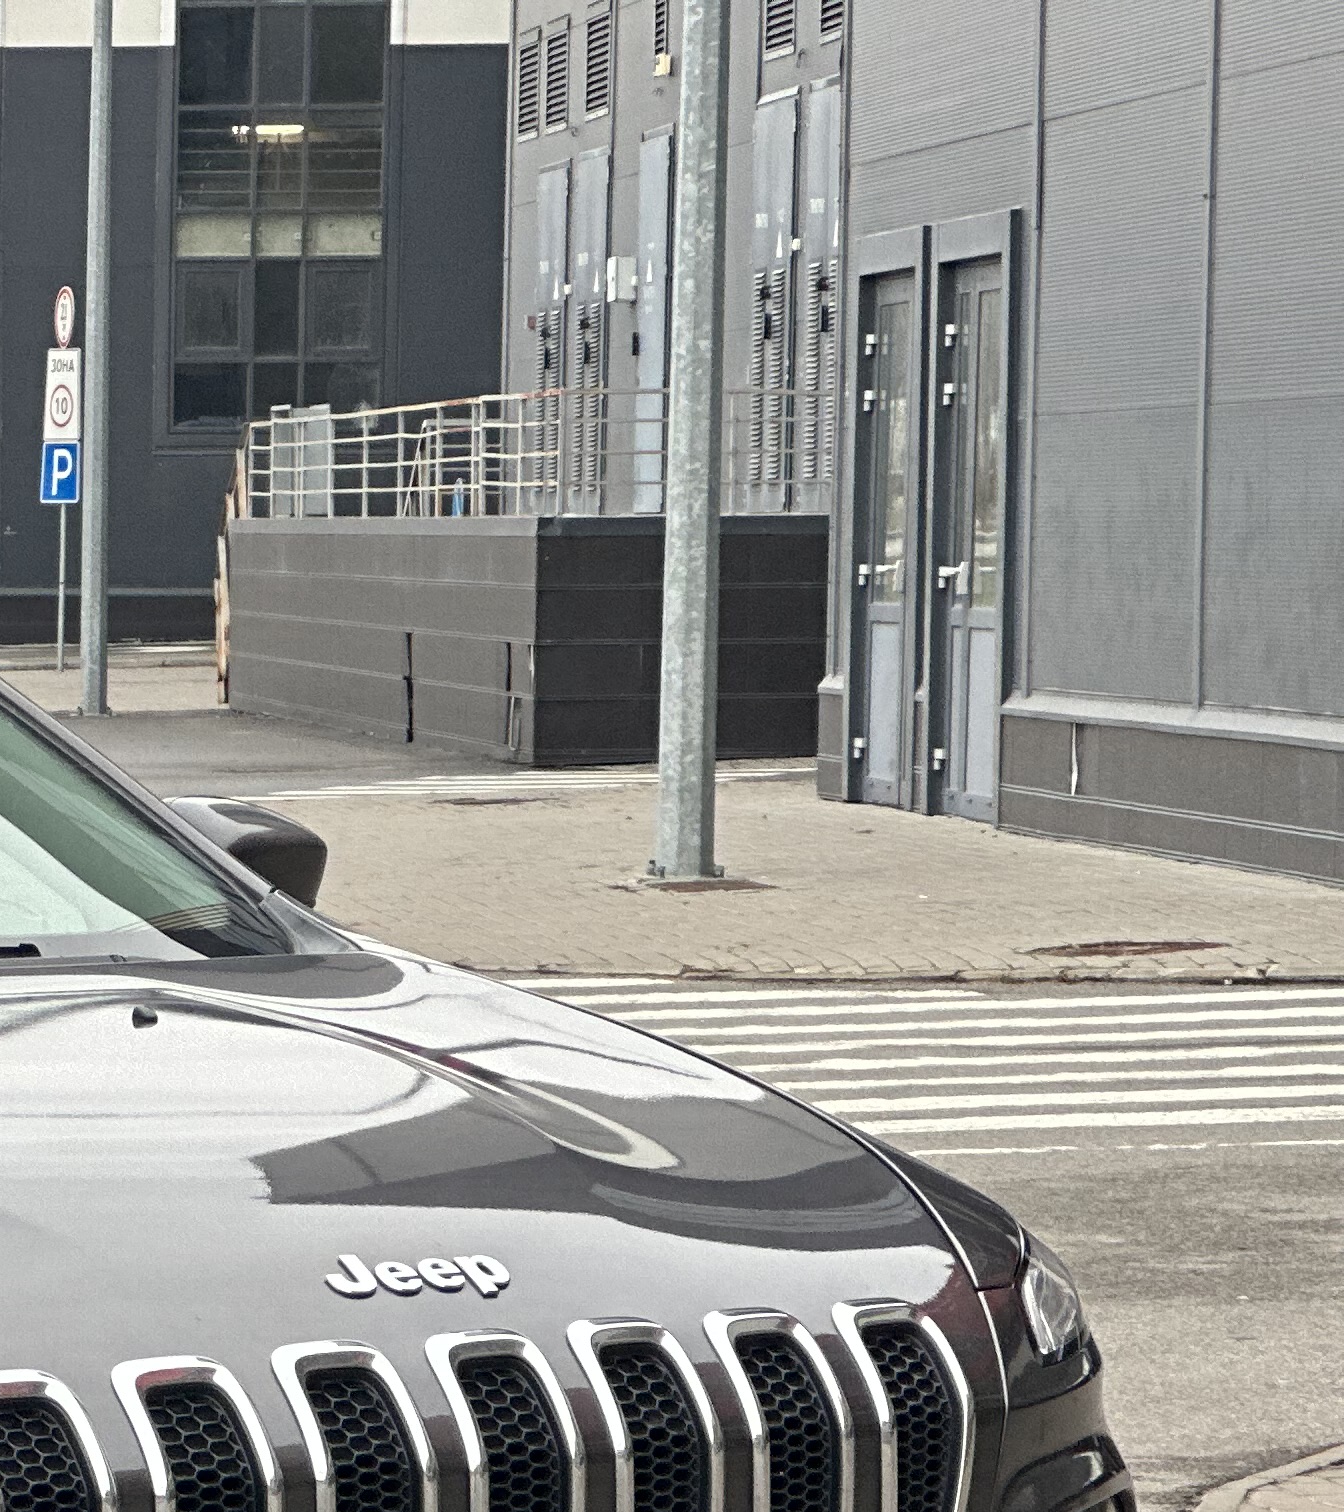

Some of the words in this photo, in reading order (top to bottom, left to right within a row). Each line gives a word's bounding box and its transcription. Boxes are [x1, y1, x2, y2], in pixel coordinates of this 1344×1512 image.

[50, 358, 75, 373] ЗОНА
[55, 396, 68, 415] 10
[51, 448, 73, 496] P
[324, 1254, 511, 1300] Jeep
